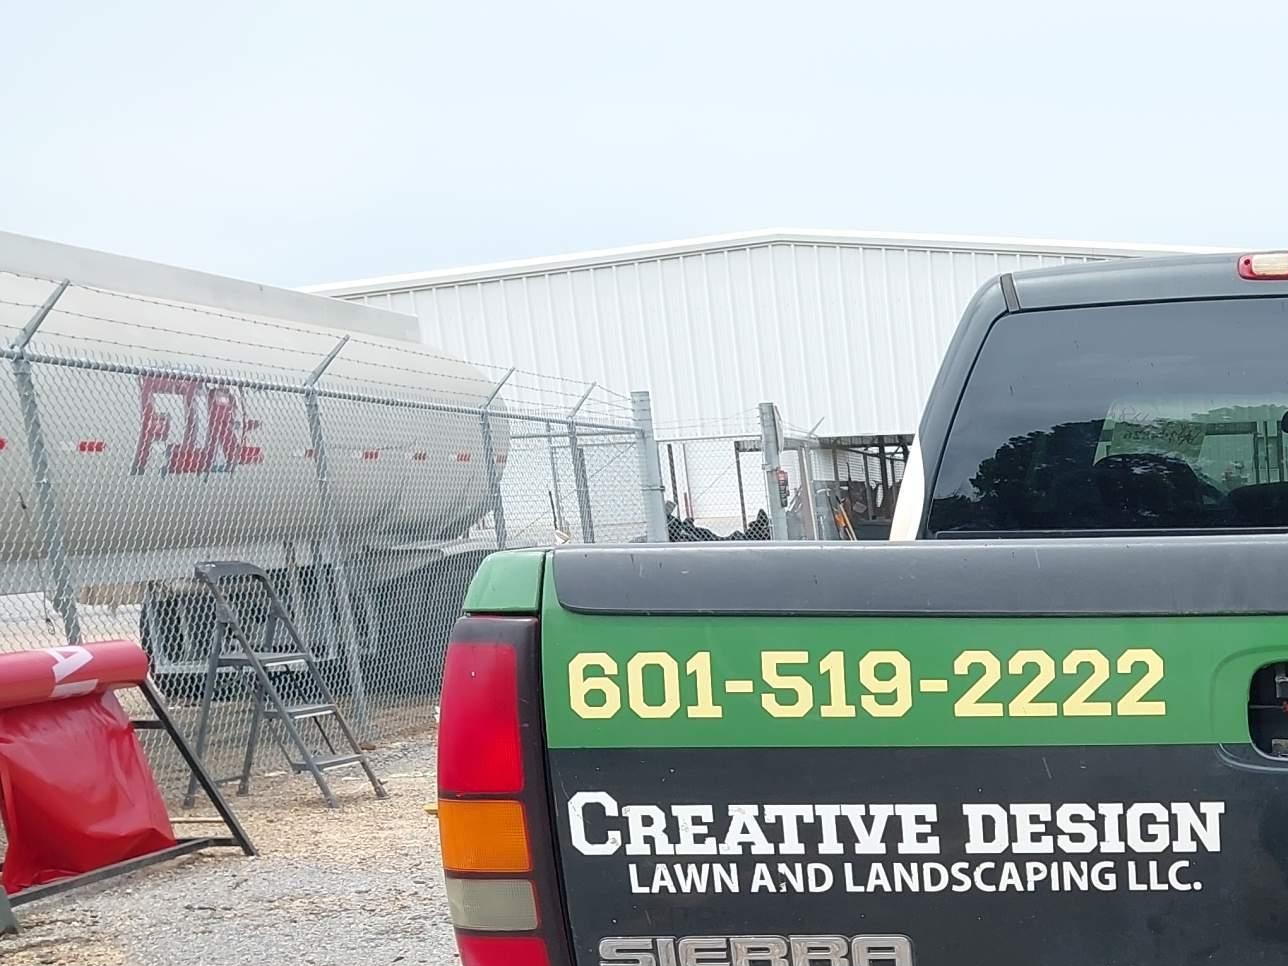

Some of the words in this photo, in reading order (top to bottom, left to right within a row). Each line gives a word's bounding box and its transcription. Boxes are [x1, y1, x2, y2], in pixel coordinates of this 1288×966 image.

[568, 648, 1166, 719] 601-519-2222
[567, 791, 941, 855] CREATIVE
[962, 801, 1225, 854] DESIGN
[628, 863, 740, 893] LAWN
[750, 862, 834, 893] AND
[844, 860, 1117, 893] LANDSCAPING
[1128, 860, 1203, 892] LLC.
